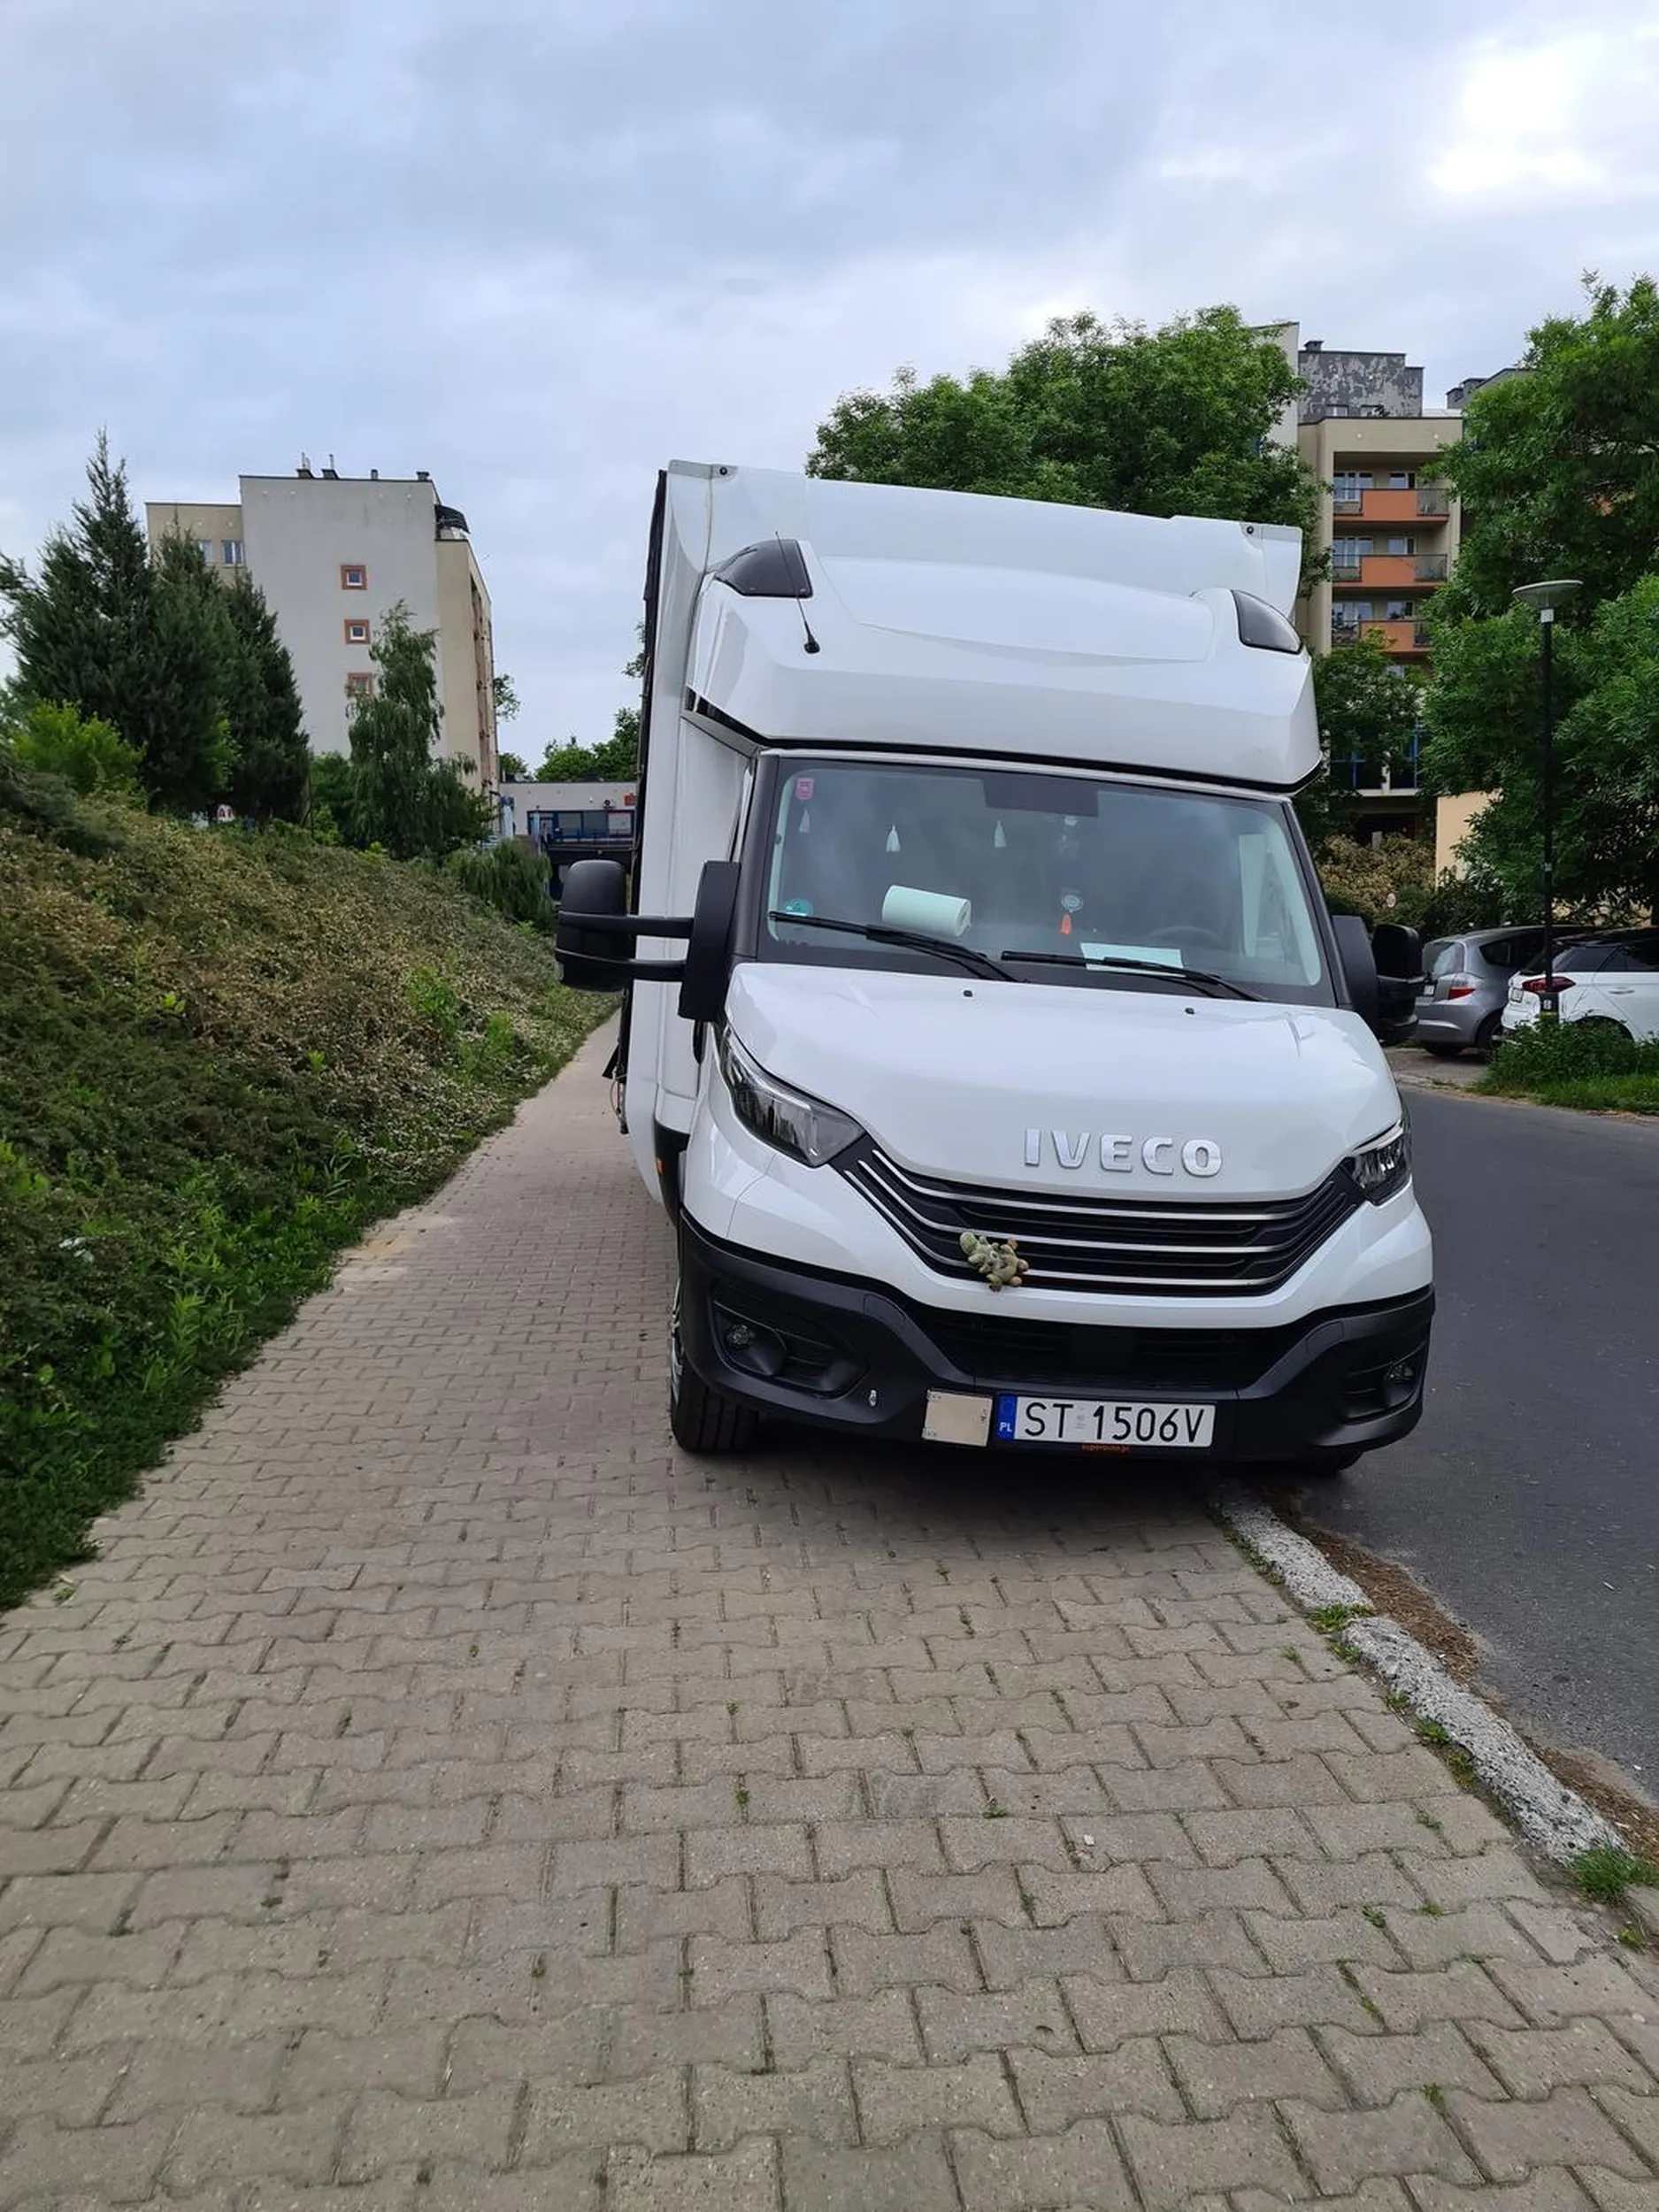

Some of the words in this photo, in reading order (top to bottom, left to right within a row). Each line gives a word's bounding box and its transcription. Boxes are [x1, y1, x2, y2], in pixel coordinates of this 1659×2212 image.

[1025, 1128, 1222, 1178] IVECO
[1000, 1422, 1013, 1432] PL
[1025, 1402, 1074, 1439] ST
[1093, 1405, 1205, 1443] 1506V
